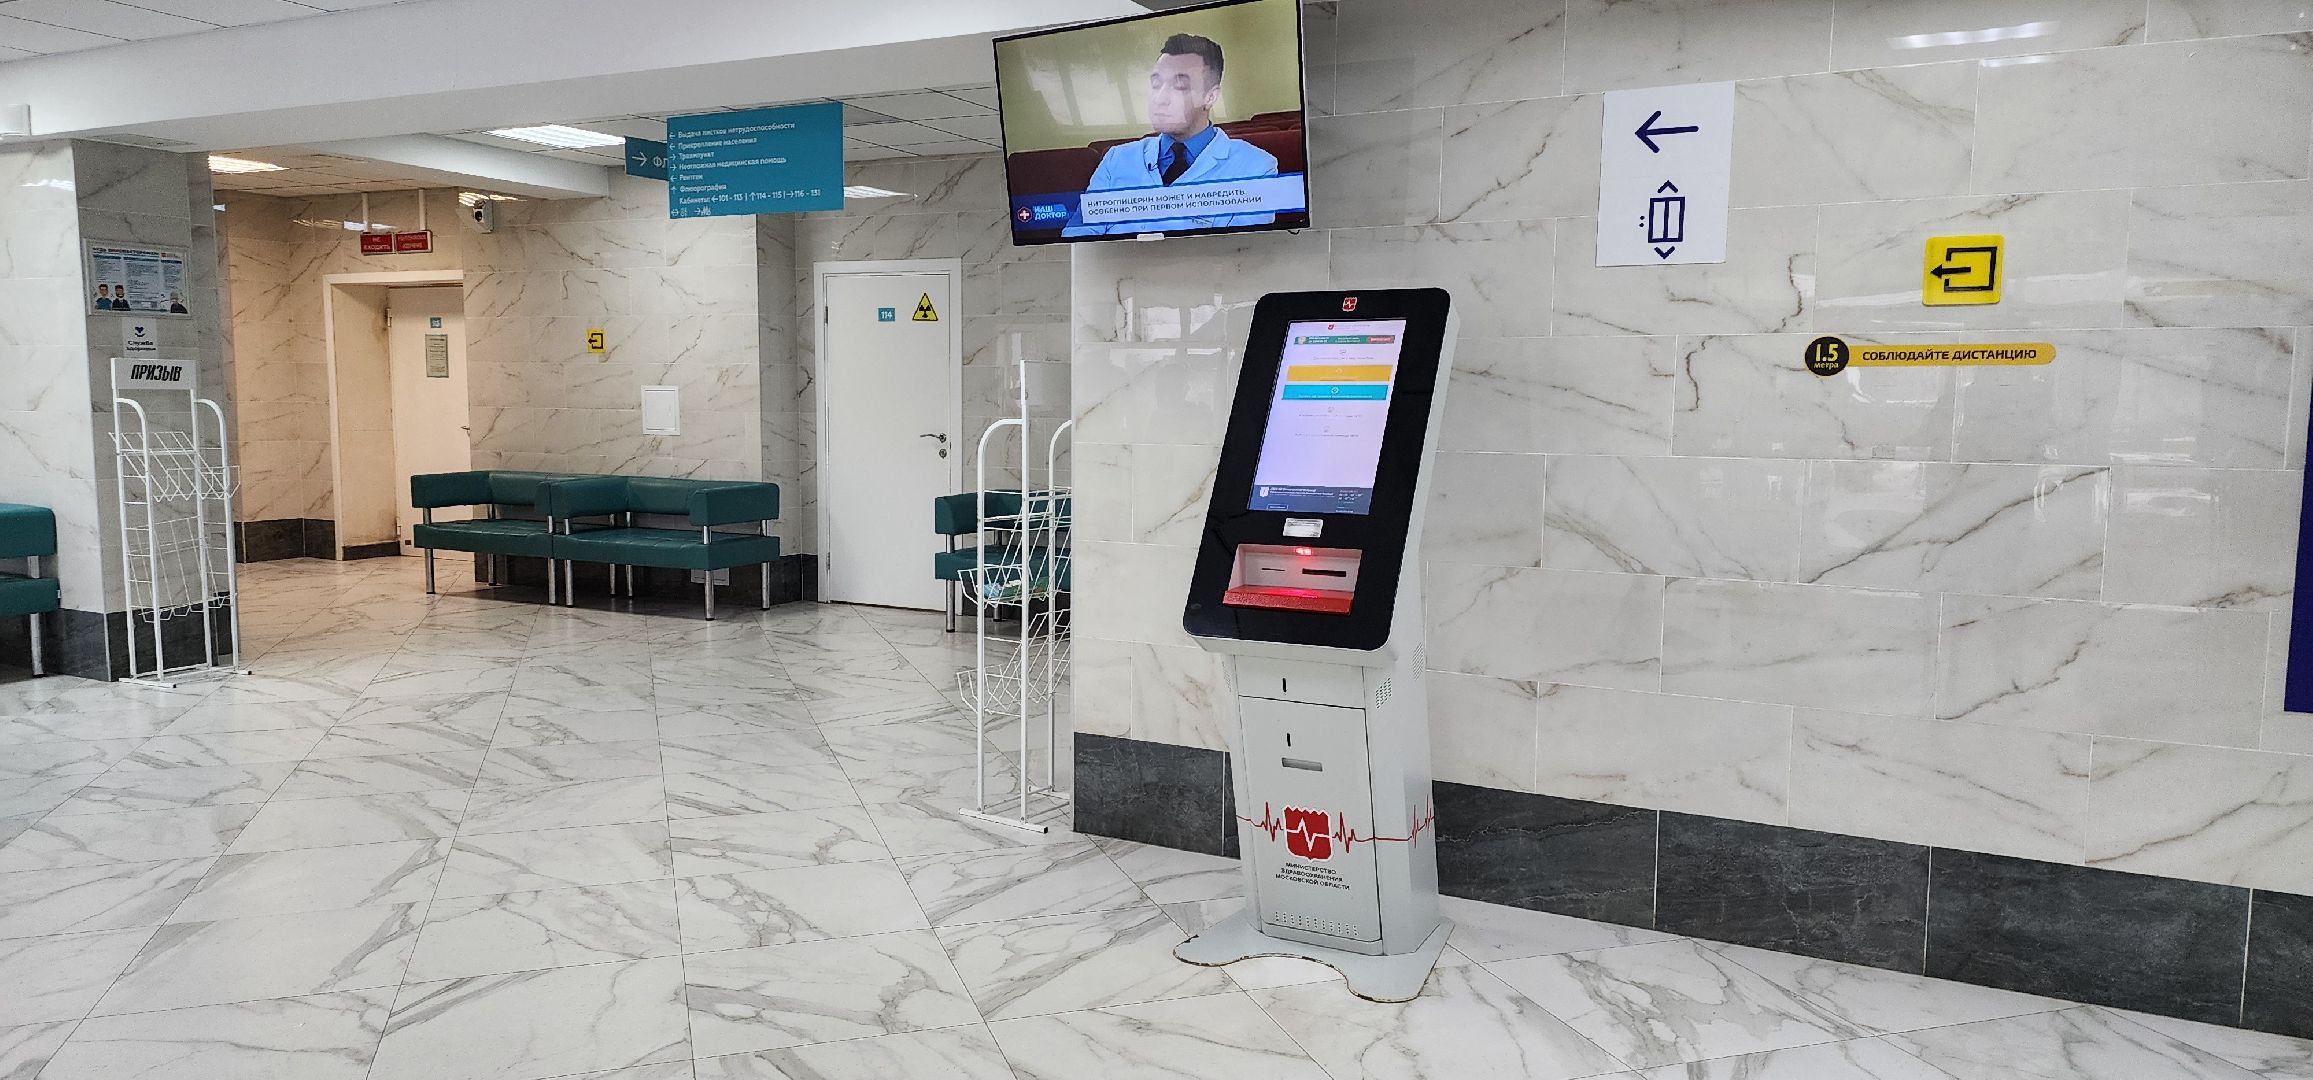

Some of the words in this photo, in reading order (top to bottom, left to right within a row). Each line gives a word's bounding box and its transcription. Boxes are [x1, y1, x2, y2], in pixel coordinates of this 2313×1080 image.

[1087, 196, 1154, 208] НИТРОГЛИЦЕРИН
[1155, 193, 1185, 202] МОЖЕТ
[1088, 206, 1130, 216] ОСОБЕННО
[1132, 205, 1148, 214] ПРИ
[1150, 203, 1184, 212] ПЕРВОМ
[1186, 196, 1262, 208] ИСПОЛЬЗОВАНИИ
[1034, 204, 1054, 213] НАШ
[1034, 211, 1067, 221] ДОКТОР
[880, 311, 893, 319] 114
[1815, 343, 1839, 362] 1.5
[1862, 348, 1949, 361] СОБЛЮДАЙТЕ
[1952, 348, 2037, 361] ДИСТАНЦИЮ
[1813, 361, 1839, 370] метра
[130, 364, 183, 382] ПРИЗЫВ
[1280, 867, 1343, 883] ЗДРАВООХРАНЕНИЯ
[1285, 862, 1337, 875] МИНИСТЕРСТВО
[1275, 872, 1319, 886] МОСКОВСКОЙ
